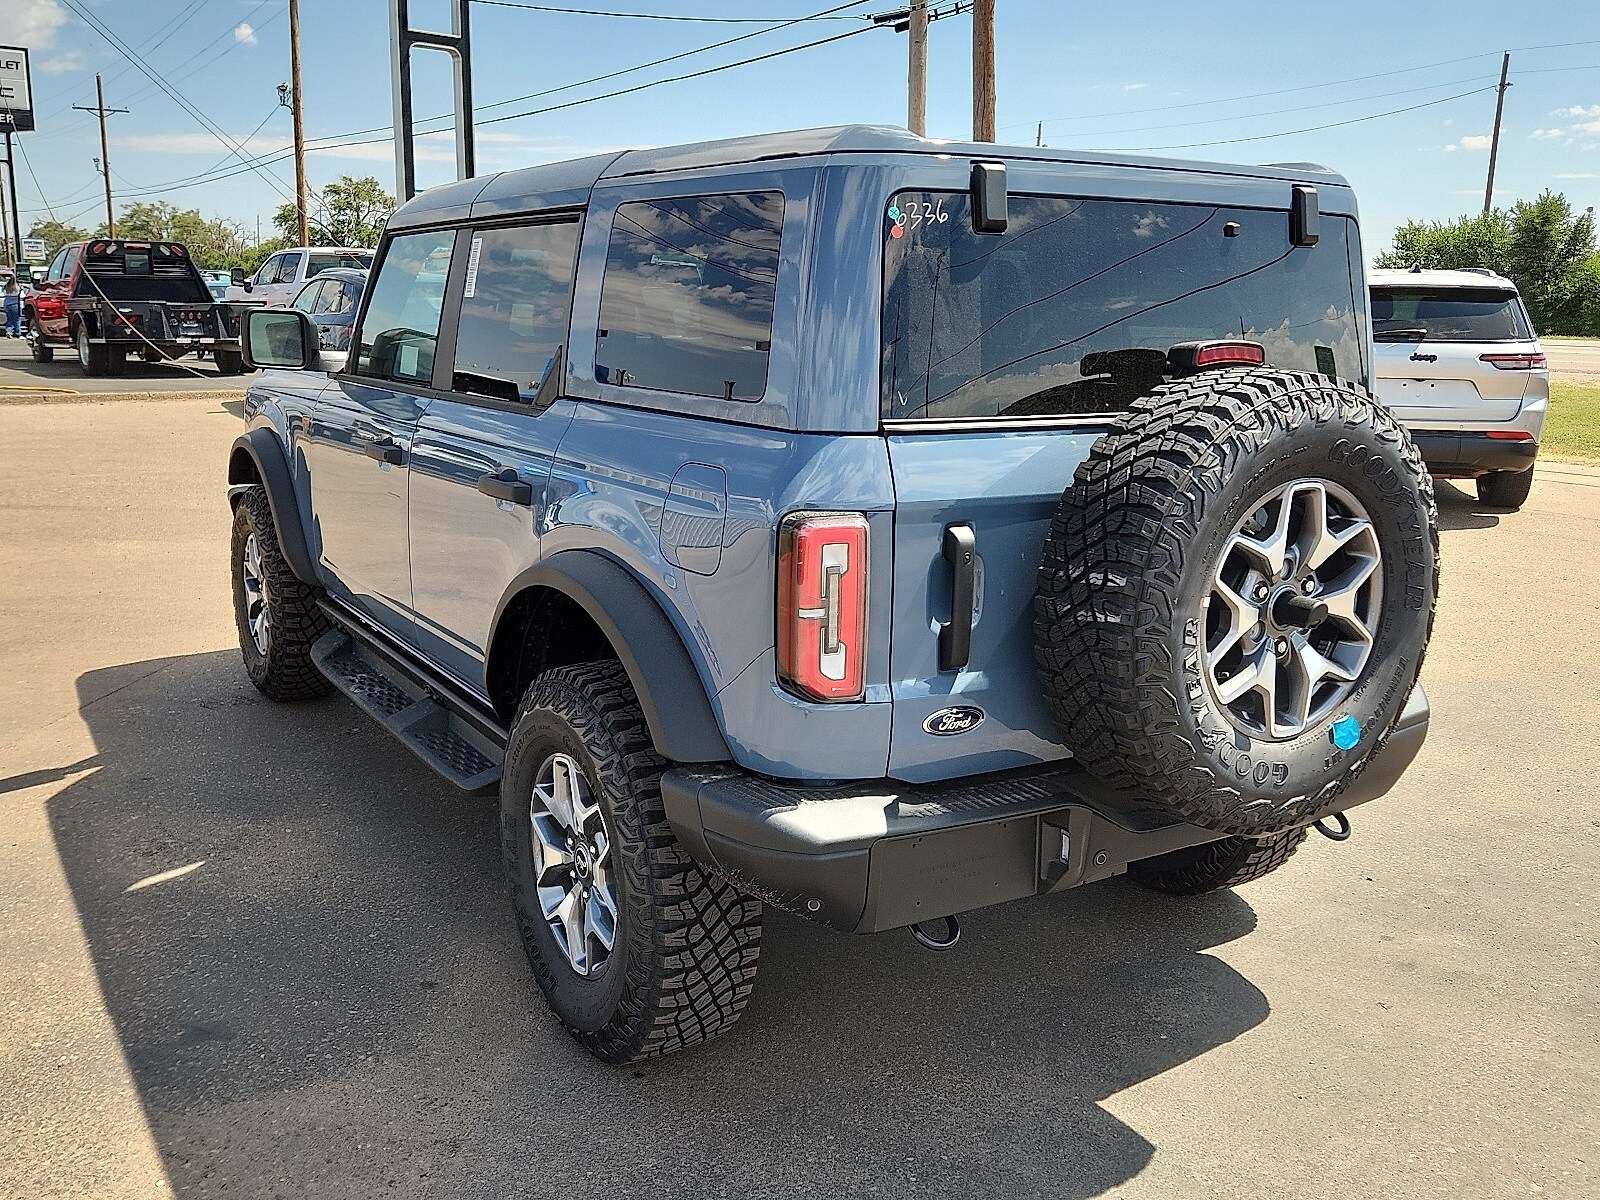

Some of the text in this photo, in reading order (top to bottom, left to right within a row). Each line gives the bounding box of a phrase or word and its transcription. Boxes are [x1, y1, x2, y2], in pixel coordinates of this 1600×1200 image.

[893, 196, 949, 230] 6336
[1409, 352, 1438, 363] Jeep
[1184, 618, 1289, 786] GOODYEAR
[938, 712, 972, 731] Ford
